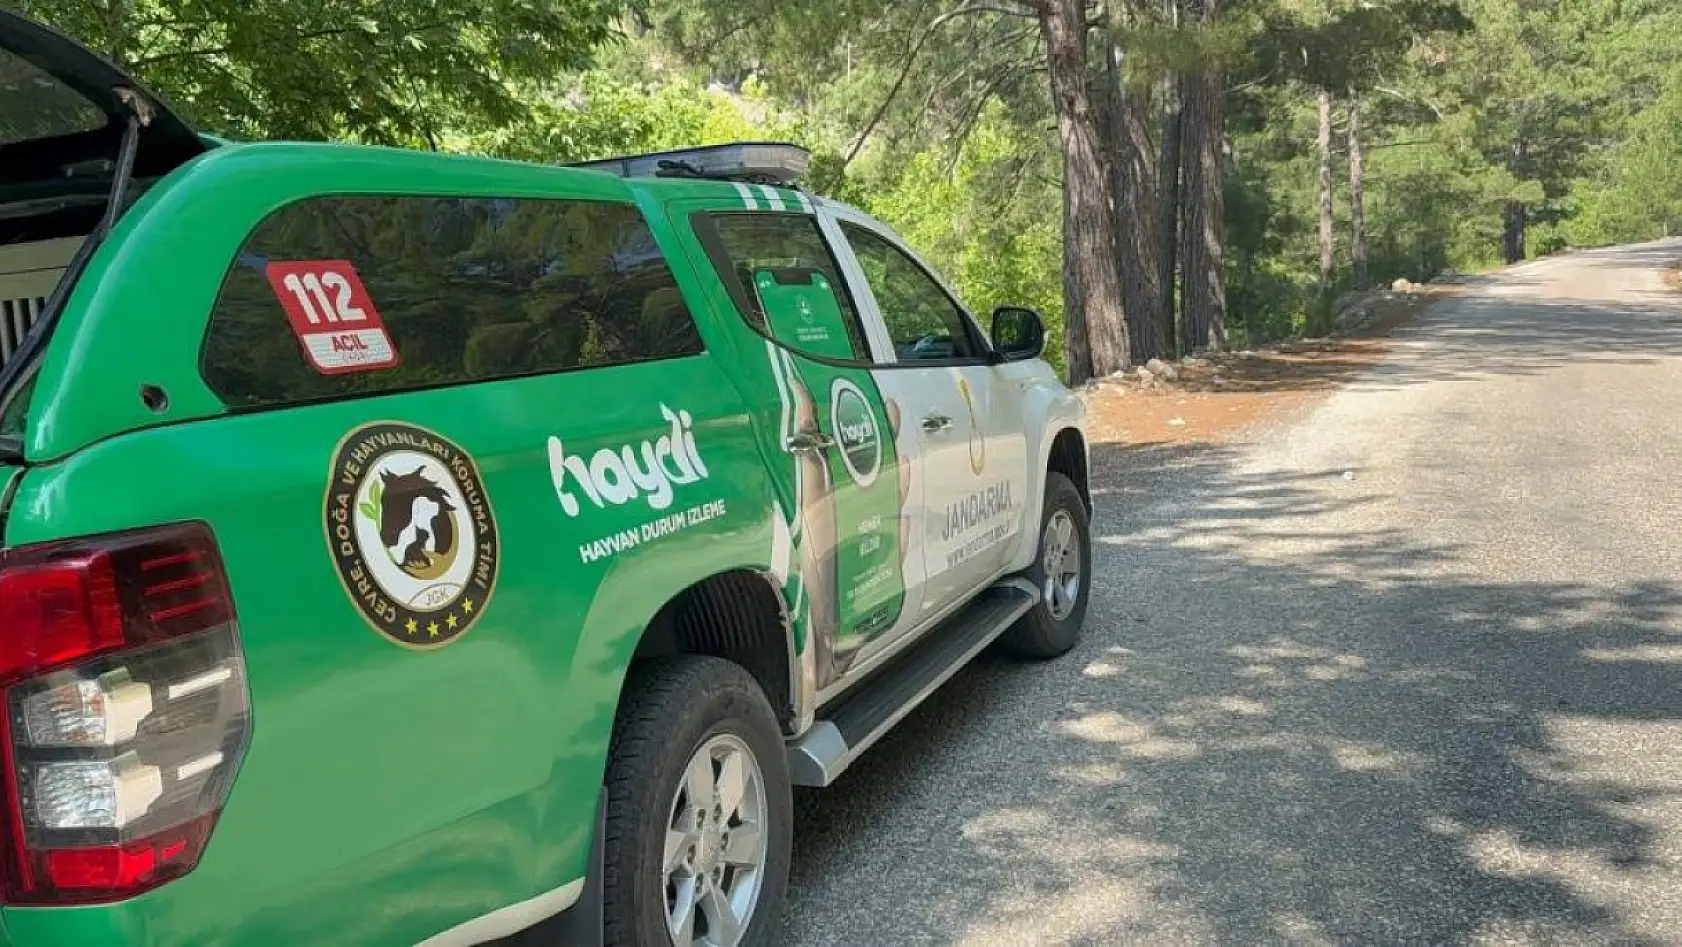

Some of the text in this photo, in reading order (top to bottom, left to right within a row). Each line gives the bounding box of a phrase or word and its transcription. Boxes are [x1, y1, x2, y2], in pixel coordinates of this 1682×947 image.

[283, 272, 366, 323] 112
[343, 462, 360, 485] VE
[352, 432, 449, 459] HAYVANLARI
[451, 454, 489, 535] KORUMA
[547, 401, 709, 517] haydi
[579, 527, 640, 563] HAYVAN
[641, 511, 686, 542] DURUM
[941, 479, 1012, 541] JANDARMA
